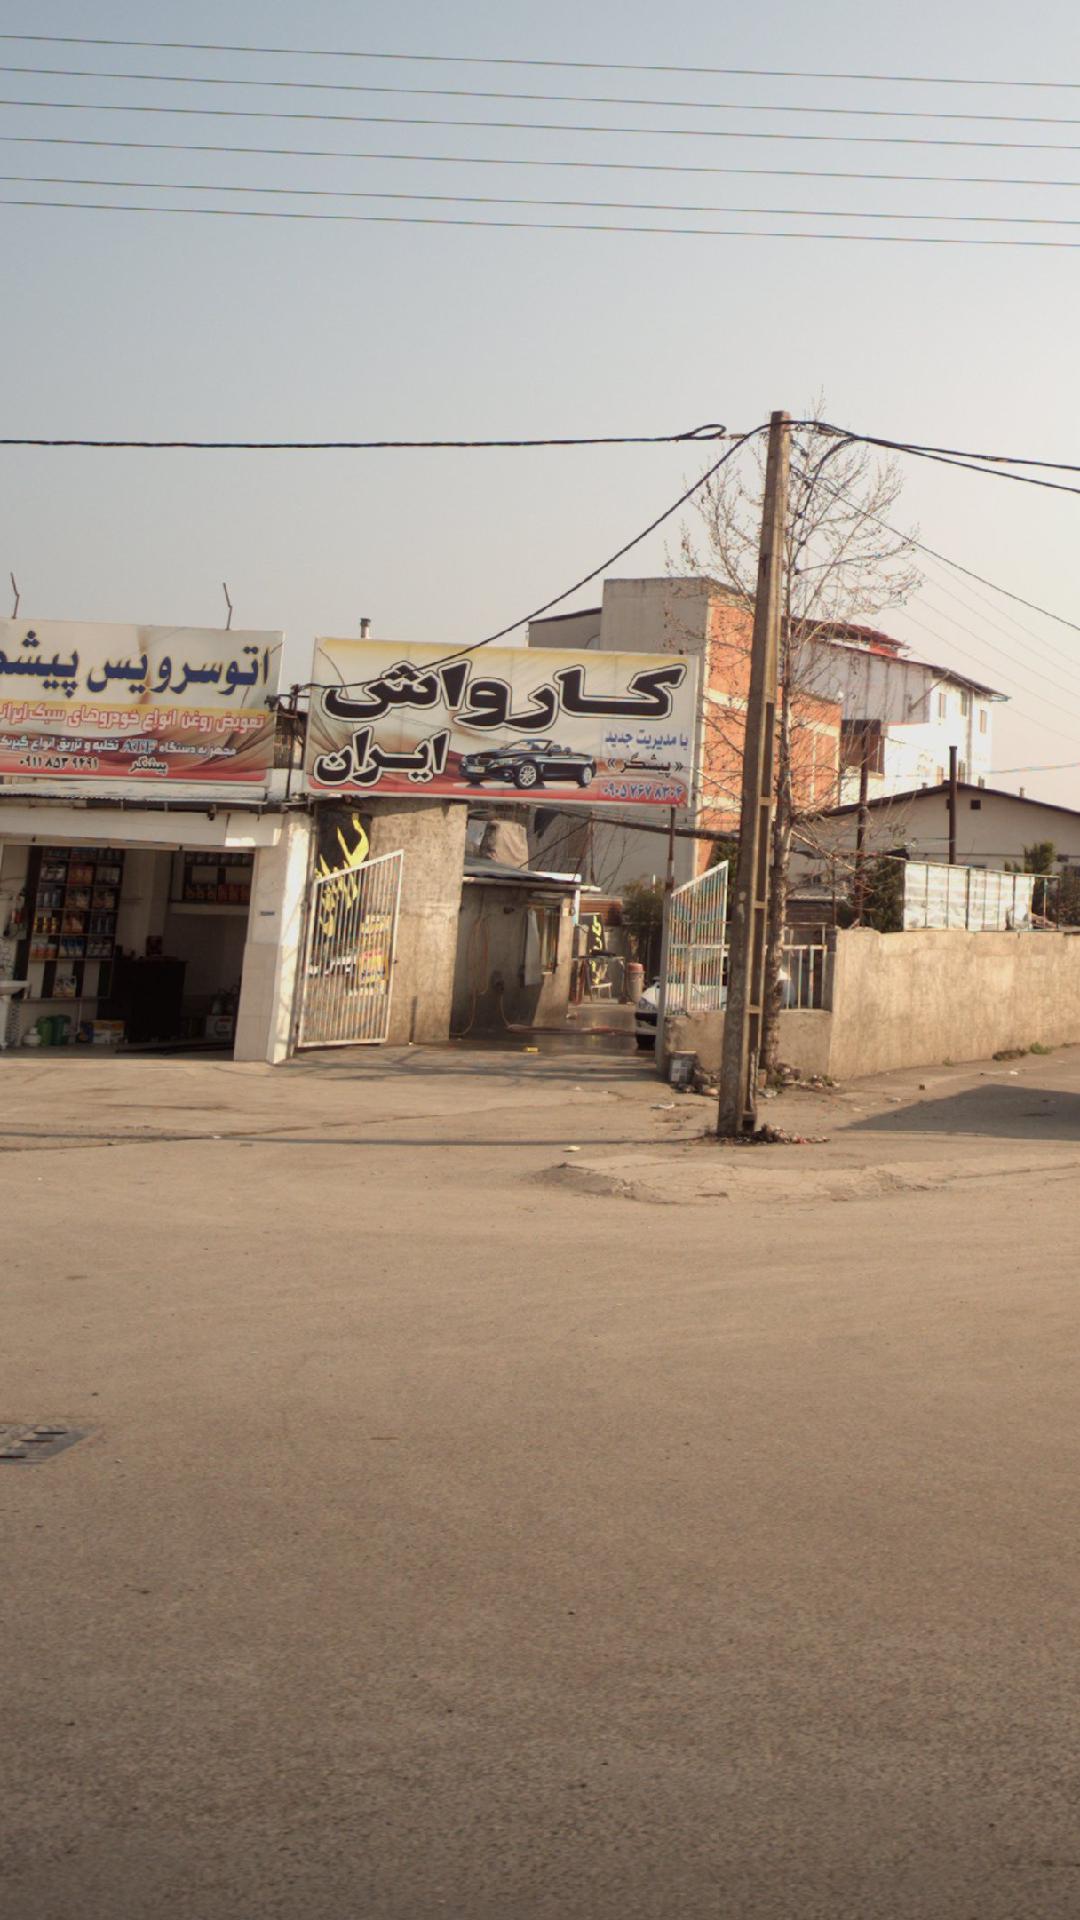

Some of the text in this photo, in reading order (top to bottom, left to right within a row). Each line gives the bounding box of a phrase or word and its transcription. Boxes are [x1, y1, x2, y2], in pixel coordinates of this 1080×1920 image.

[0, 630, 78, 698] پیش
[324, 660, 687, 733] کارواش
[30, 703, 66, 724] سبک
[142, 708, 177, 731] انواع
[181, 710, 213, 732] روغن
[215, 711, 265, 733] تعویض
[31, 736, 55, 752] انواع
[56, 737, 82, 752] تزریق
[92, 739, 119, 753] تخلیه
[159, 740, 196, 754] دستگاه
[605, 732, 633, 748] جدید
[636, 729, 677, 750] مدیریت
[315, 727, 451, 785] ایران
